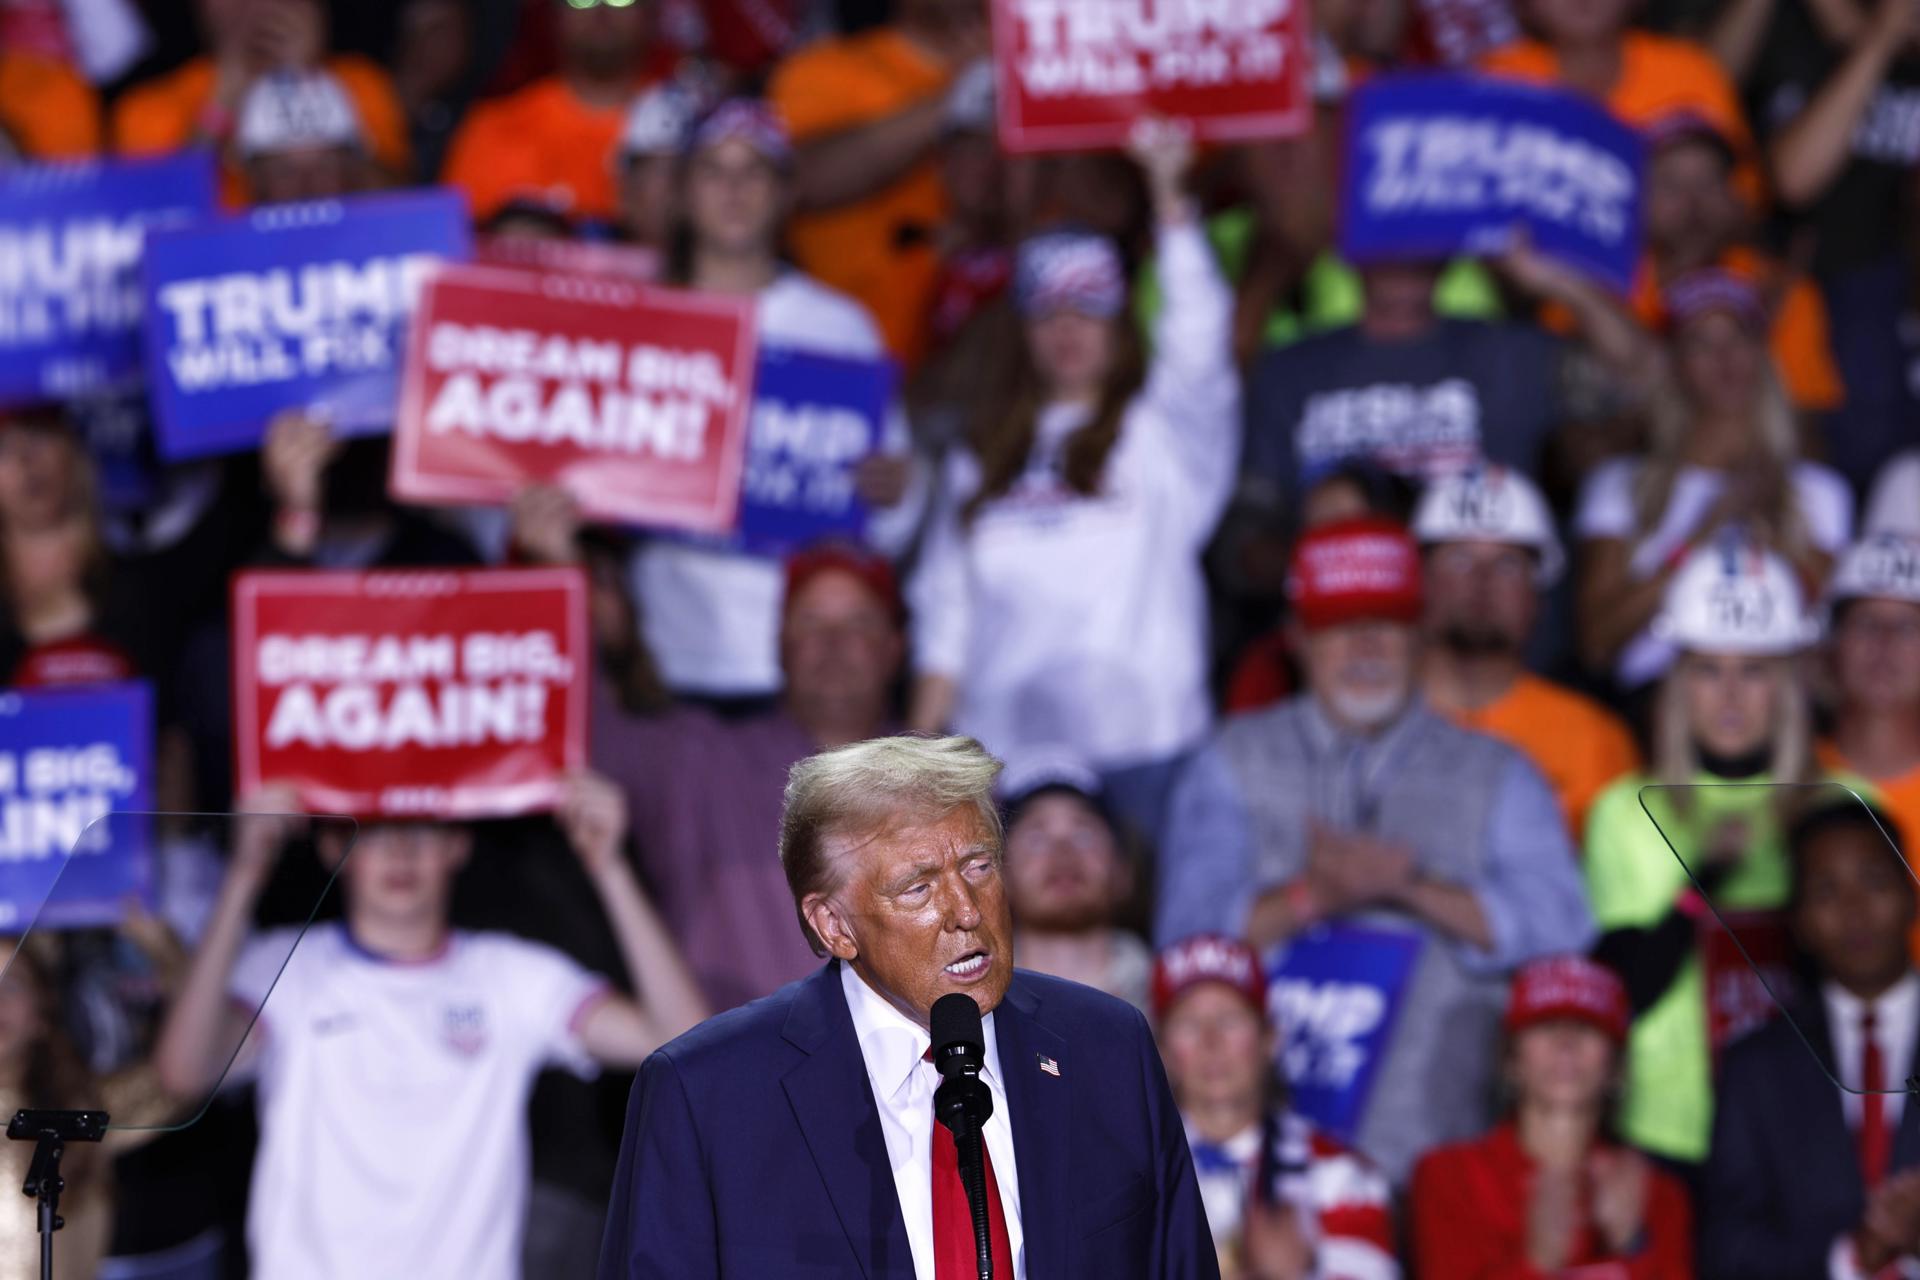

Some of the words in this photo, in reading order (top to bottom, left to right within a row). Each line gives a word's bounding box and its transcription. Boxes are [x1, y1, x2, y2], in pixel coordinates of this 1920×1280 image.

[1363, 117, 1637, 206] TRUMP
[166, 334, 298, 394] WILL
[428, 322, 623, 382] DREAM
[627, 343, 738, 408] BIG,
[424, 372, 711, 462] AGAIN!
[256, 632, 456, 684] DREAM
[461, 630, 575, 684] BIG,
[265, 680, 550, 751] AGAIN!
[23, 743, 138, 799] BIG,
[0, 795, 114, 862] IN!
